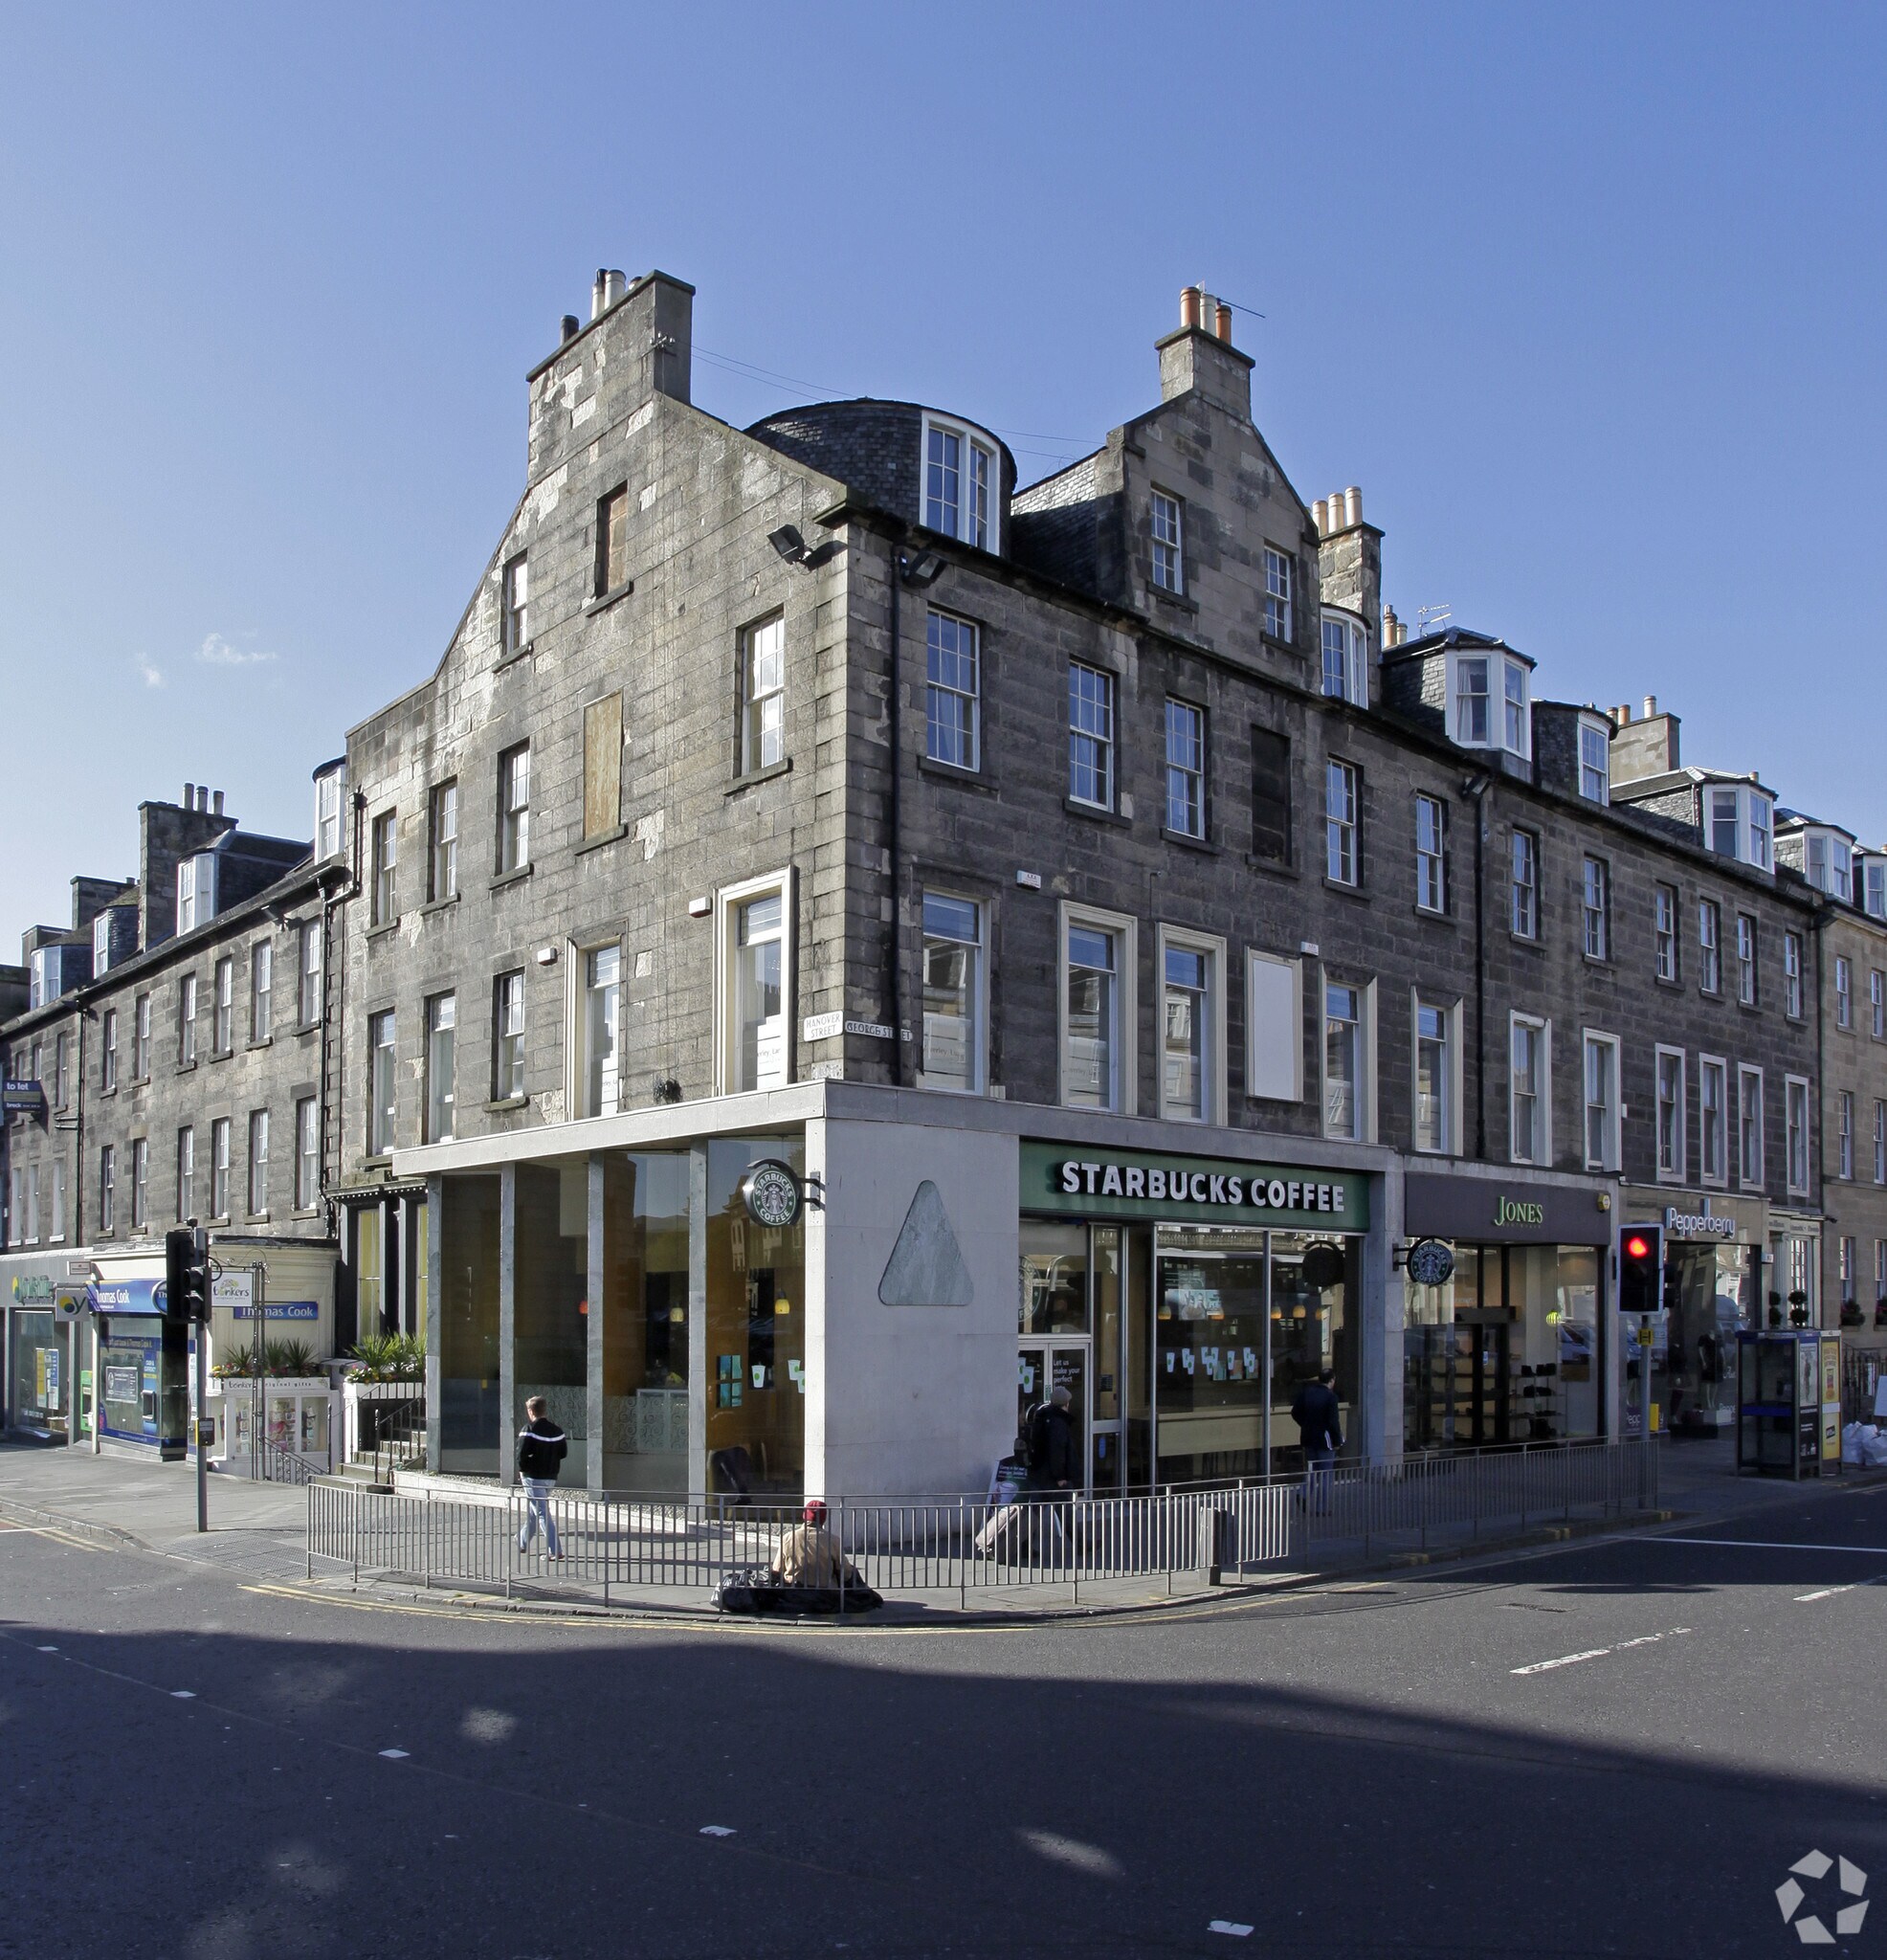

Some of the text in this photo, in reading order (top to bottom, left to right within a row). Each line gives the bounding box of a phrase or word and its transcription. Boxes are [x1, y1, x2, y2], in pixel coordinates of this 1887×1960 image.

[806, 1013, 840, 1029] HANOVER
[810, 1025, 836, 1038] STREET
[847, 1022, 910, 1040] GEORGE STET
[755, 1172, 794, 1197] STARBUCKS
[1062, 1161, 1344, 1212] STARBUCKS COFFEE
[760, 1208, 790, 1223] COFFEE
[1667, 1198, 1736, 1239] Pepperberry
[1413, 1245, 1447, 1263] STARBUCKS
[1416, 1271, 1442, 1282] COFFEE
[116, 1289, 130, 1303] Cook
[288, 1306, 314, 1317] Cook
